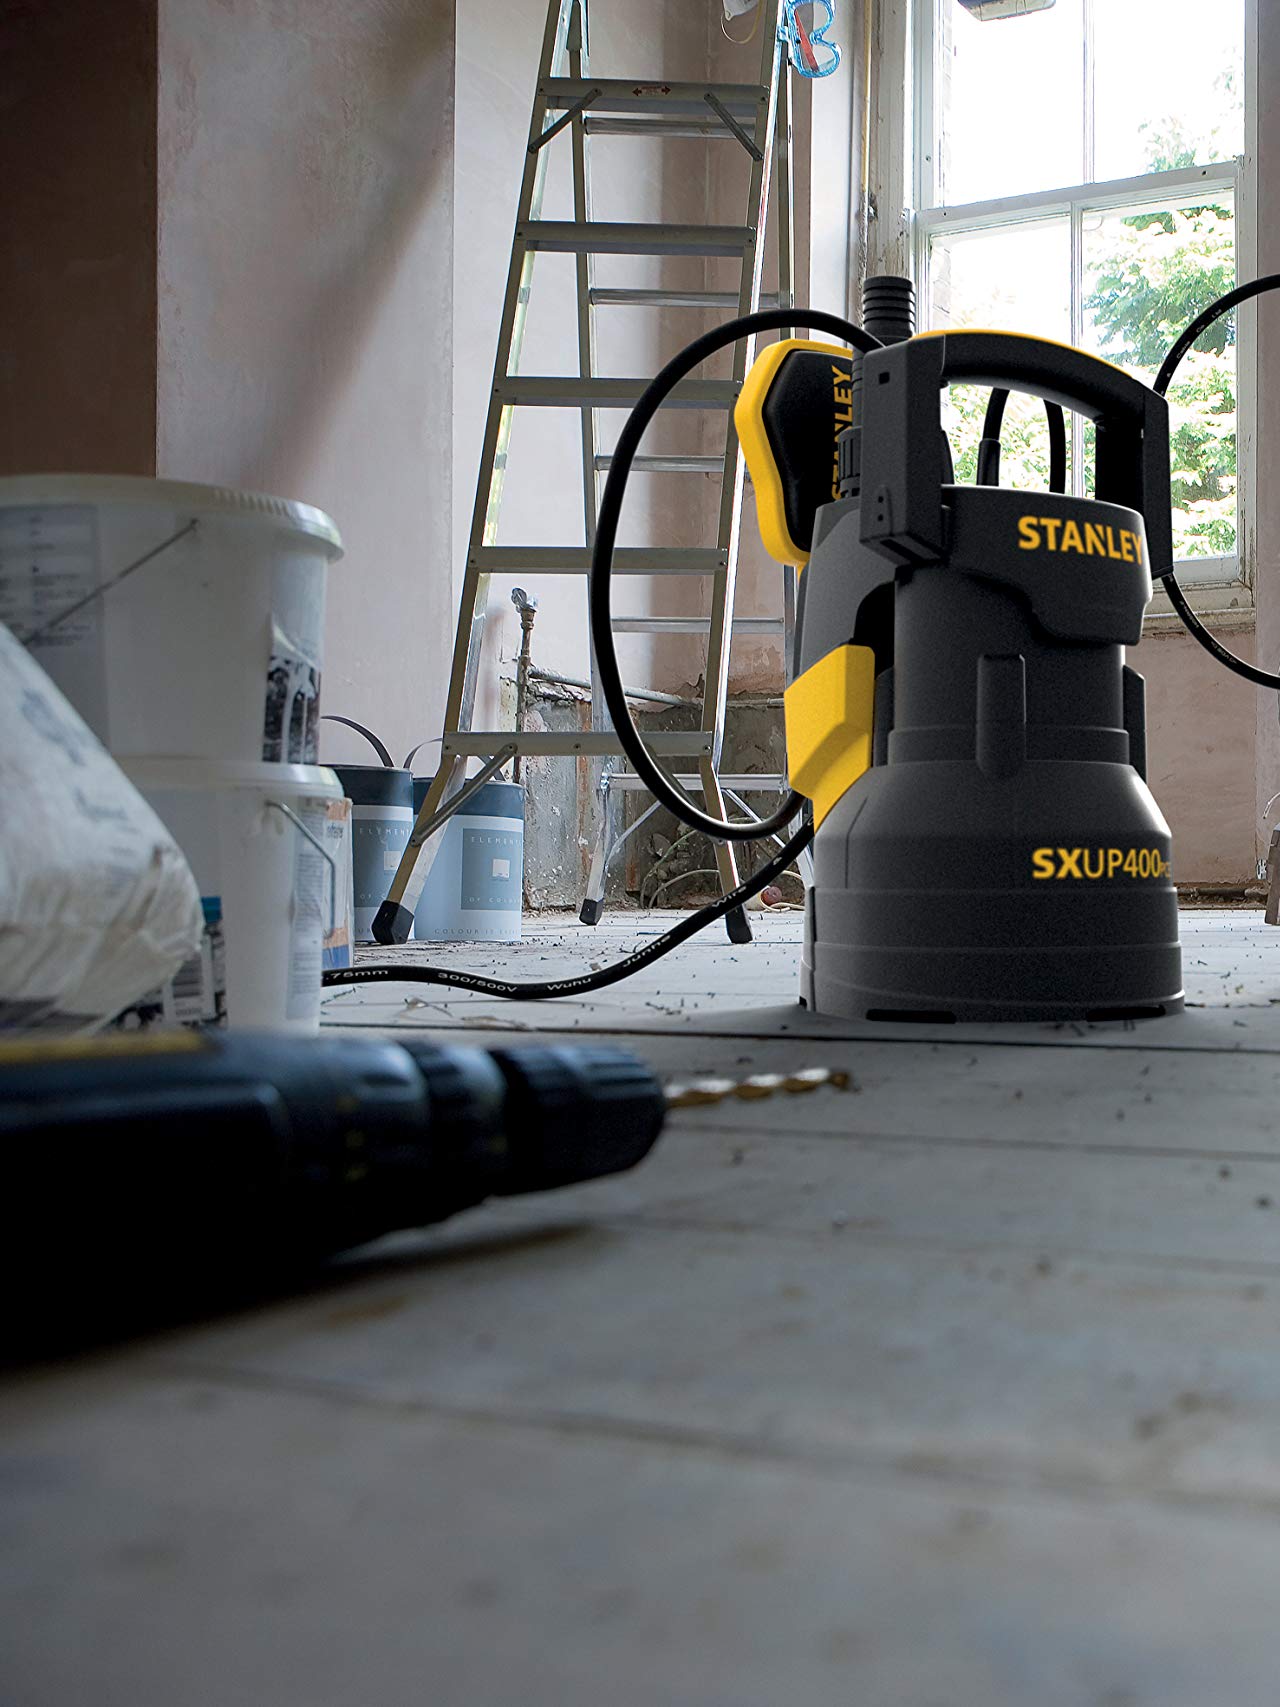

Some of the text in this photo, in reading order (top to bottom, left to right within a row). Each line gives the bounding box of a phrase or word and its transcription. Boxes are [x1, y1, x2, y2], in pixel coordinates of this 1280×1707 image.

[1018, 515, 1142, 566] STANLEY
[437, 972, 517, 992] 300/500V
[546, 977, 592, 991] Wuhu
[712, 886, 748, 908] Wire
